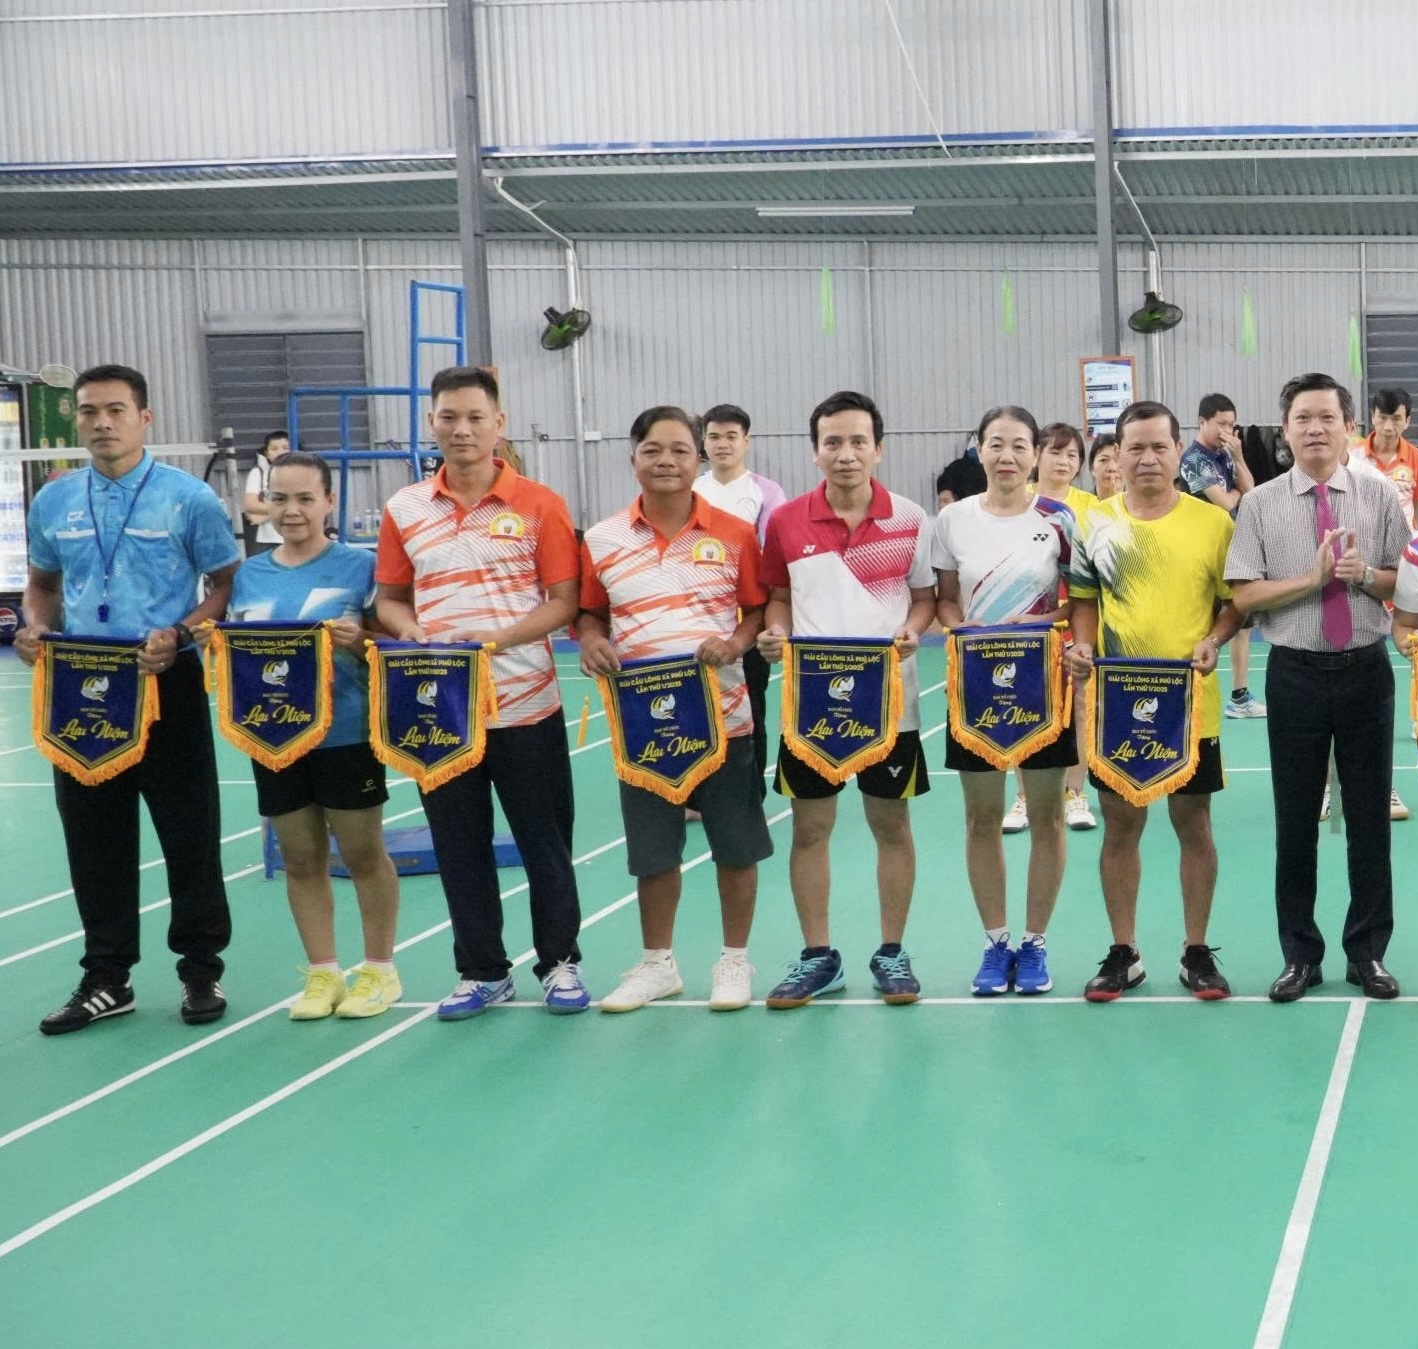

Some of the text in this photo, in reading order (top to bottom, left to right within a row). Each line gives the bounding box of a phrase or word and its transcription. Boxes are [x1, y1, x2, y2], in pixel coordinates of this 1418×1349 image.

[241, 705, 311, 726] Lưu Niệm
[974, 706, 1040, 728] Lưu Niệm
[58, 719, 129, 741] Lưu Niệm
[398, 726, 460, 748] Lưu Niệm
[805, 719, 875, 740] Lưu Niệm
[637, 737, 706, 763] Lưu Niệm
[1110, 741, 1178, 762] Lưu Niệm
